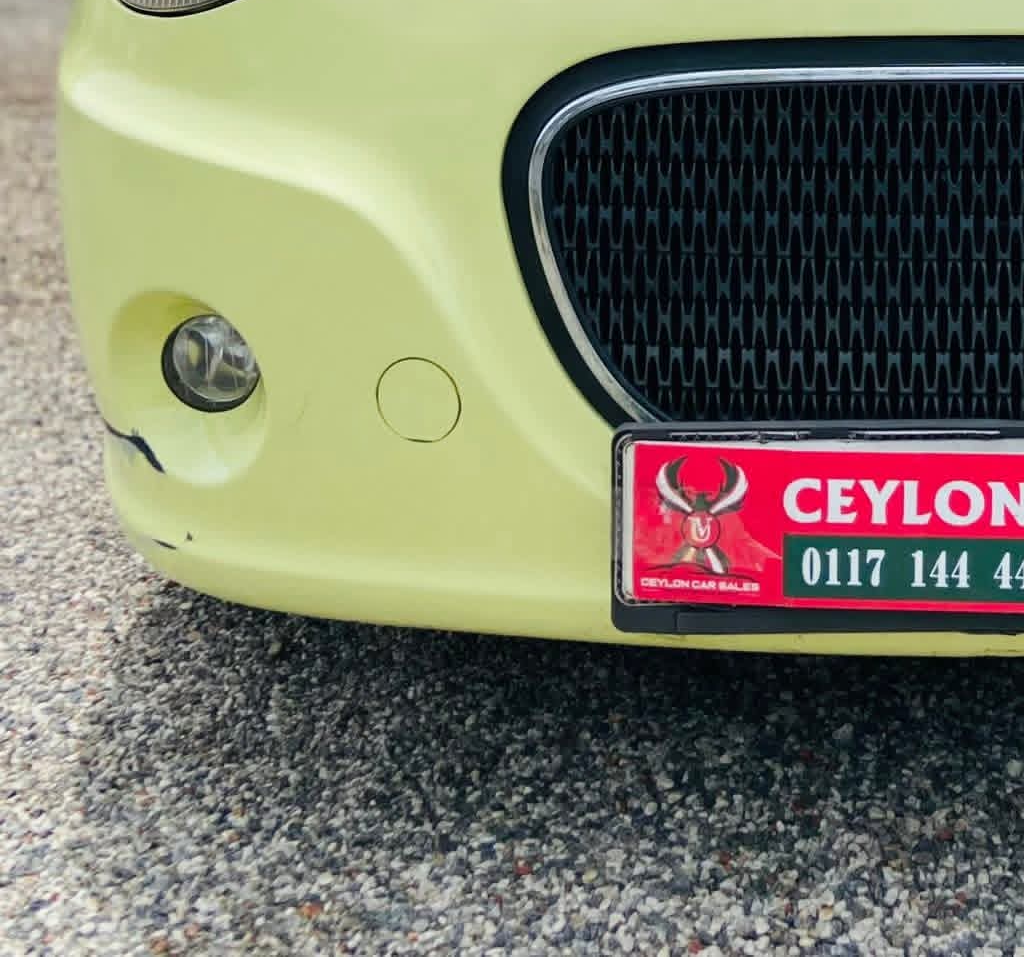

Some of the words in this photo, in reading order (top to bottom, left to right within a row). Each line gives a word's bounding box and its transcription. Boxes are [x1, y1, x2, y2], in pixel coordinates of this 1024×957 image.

[801, 546, 886, 588] 0117
[910, 550, 970, 588] 144
[640, 577, 690, 589] CEYLON
[691, 579, 717, 591] CAR
[718, 581, 760, 592] SALES
